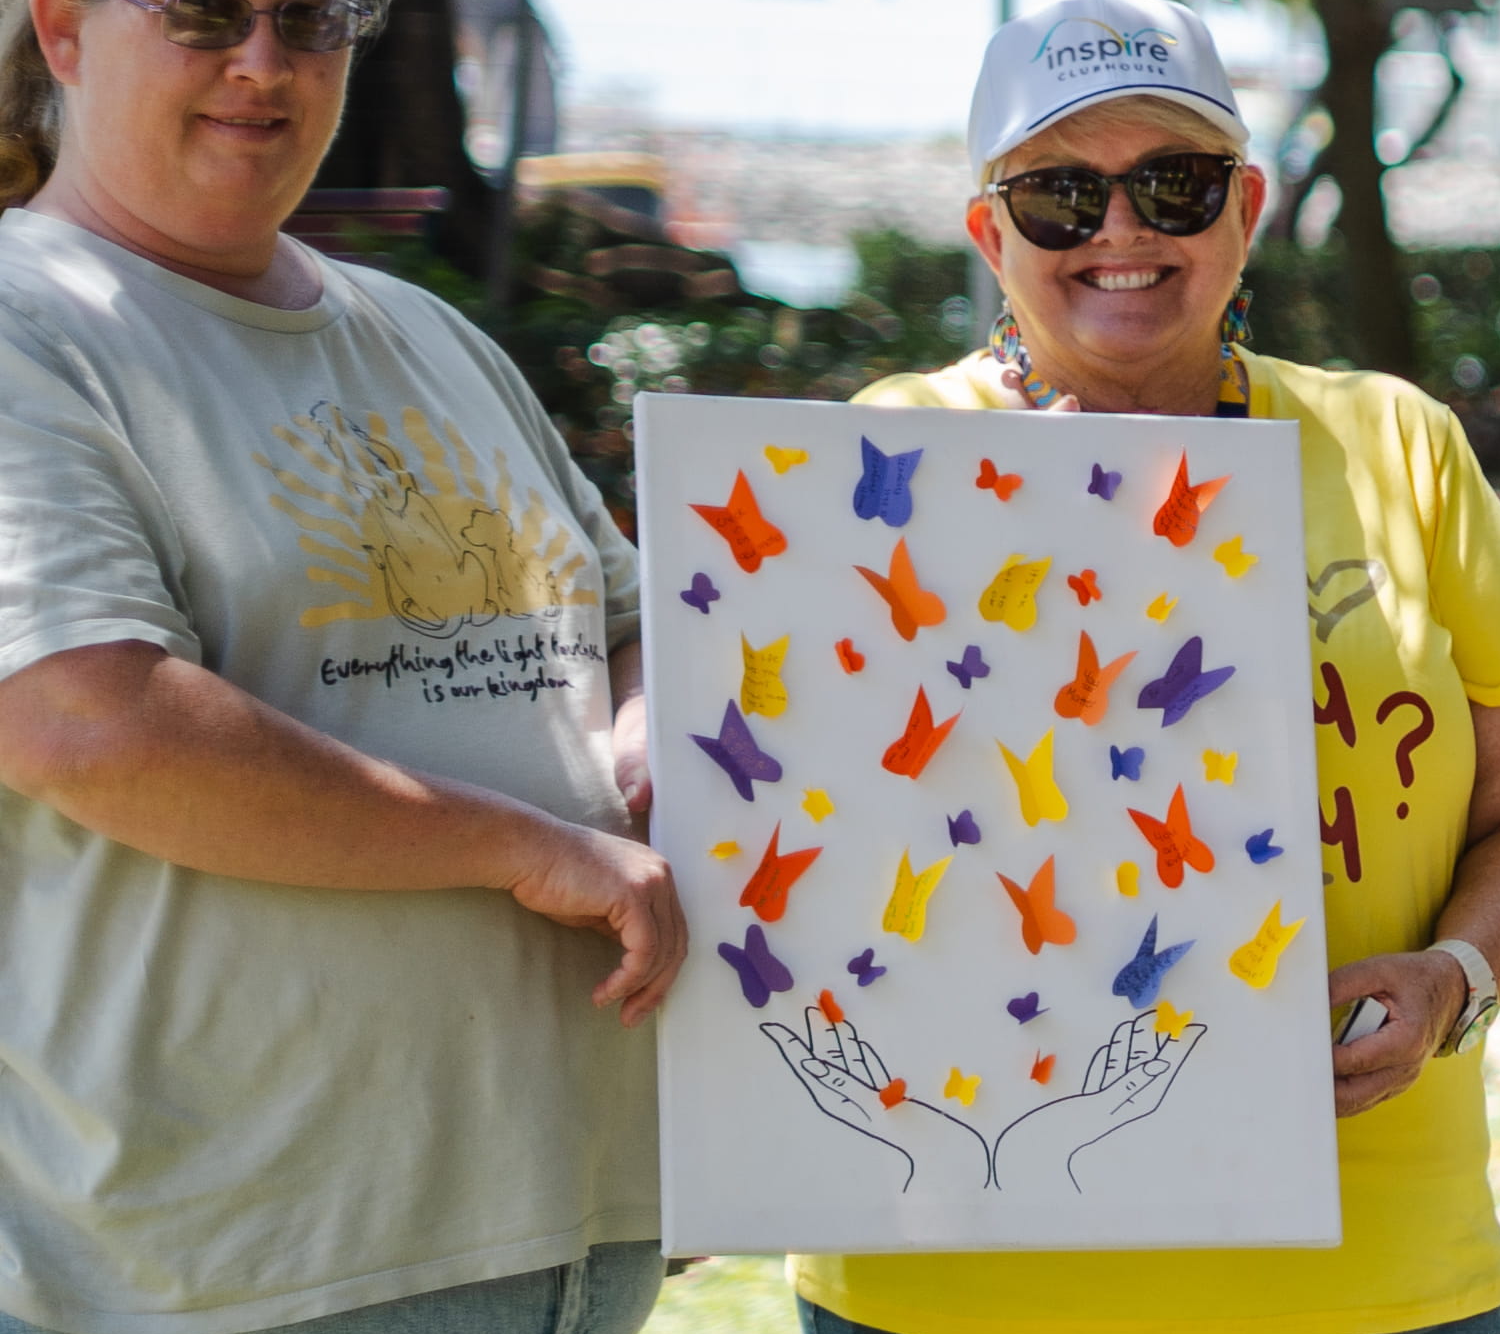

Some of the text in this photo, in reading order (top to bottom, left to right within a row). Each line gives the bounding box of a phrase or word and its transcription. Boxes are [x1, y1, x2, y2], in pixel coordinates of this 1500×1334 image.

[1046, 32, 1169, 70] inspire
[1057, 63, 1165, 81] CLUBHOUSE
[321, 641, 454, 687] Everything
[455, 639, 496, 669] the
[496, 632, 547, 672] light
[422, 667, 575, 703] is our kingdom
